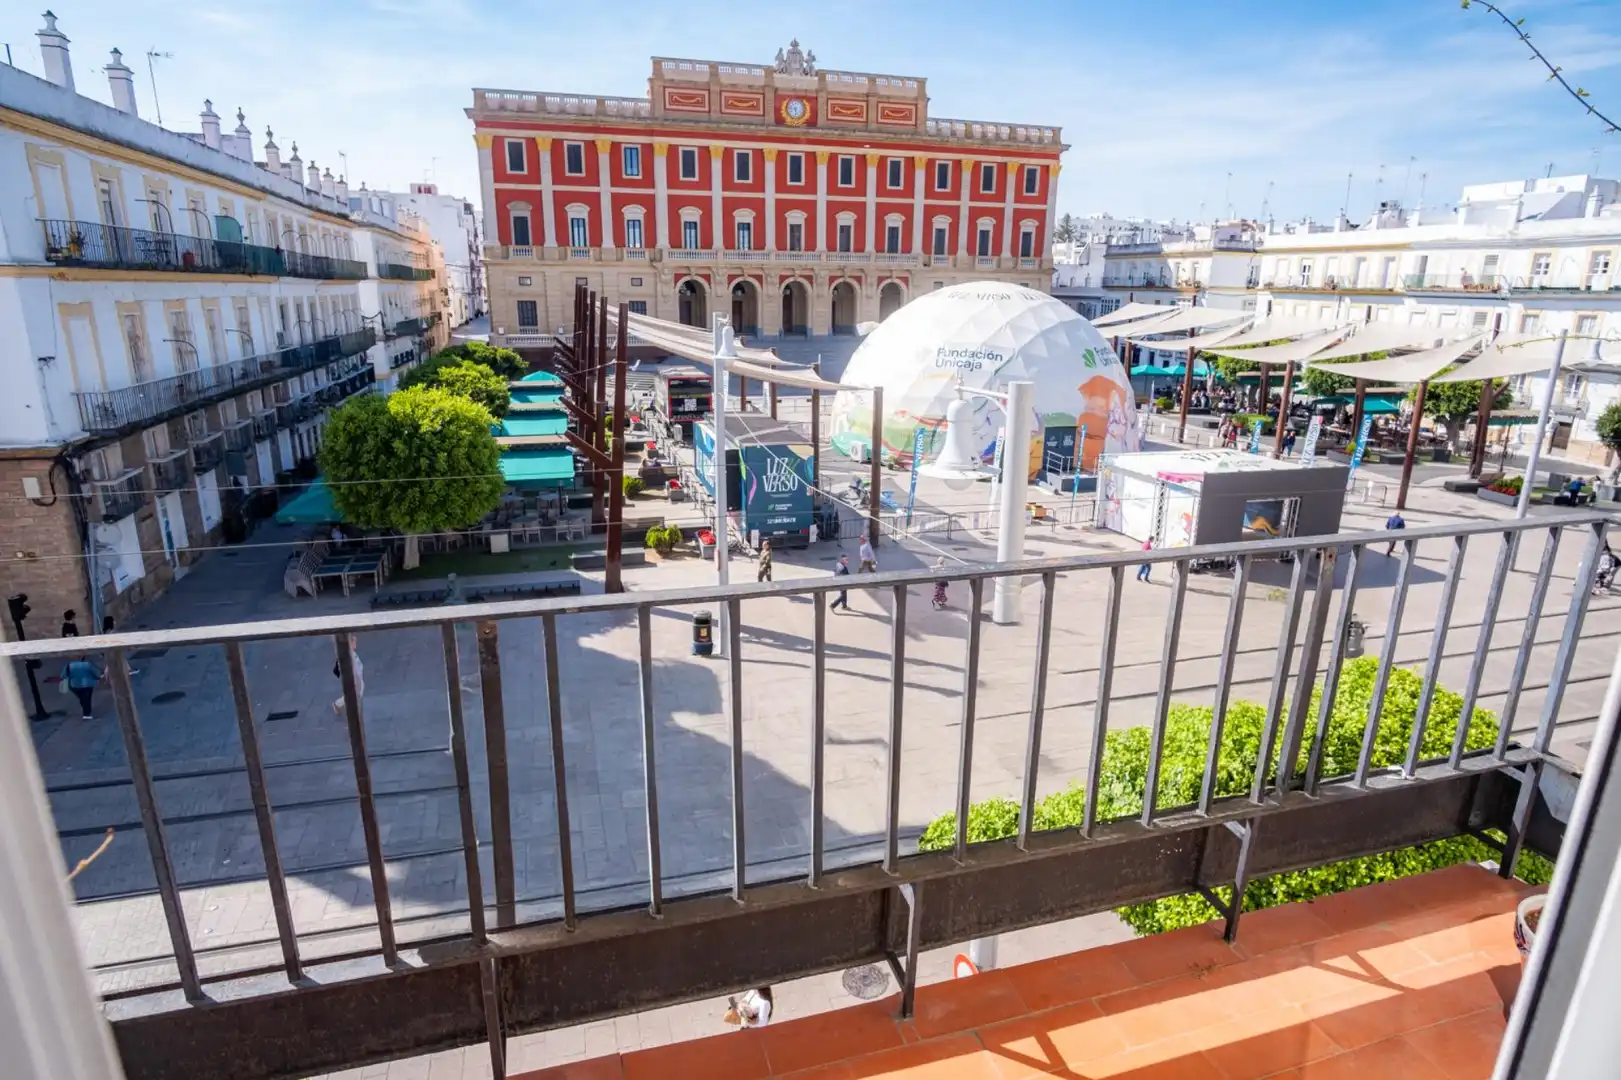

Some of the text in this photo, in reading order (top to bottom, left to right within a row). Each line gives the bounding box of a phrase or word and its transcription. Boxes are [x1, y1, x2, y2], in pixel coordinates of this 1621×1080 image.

[937, 347, 1003, 361] Fundación
[936, 358, 982, 372] Unicaja
[766, 457, 788, 476] LUZ
[762, 474, 798, 492] VERSO
